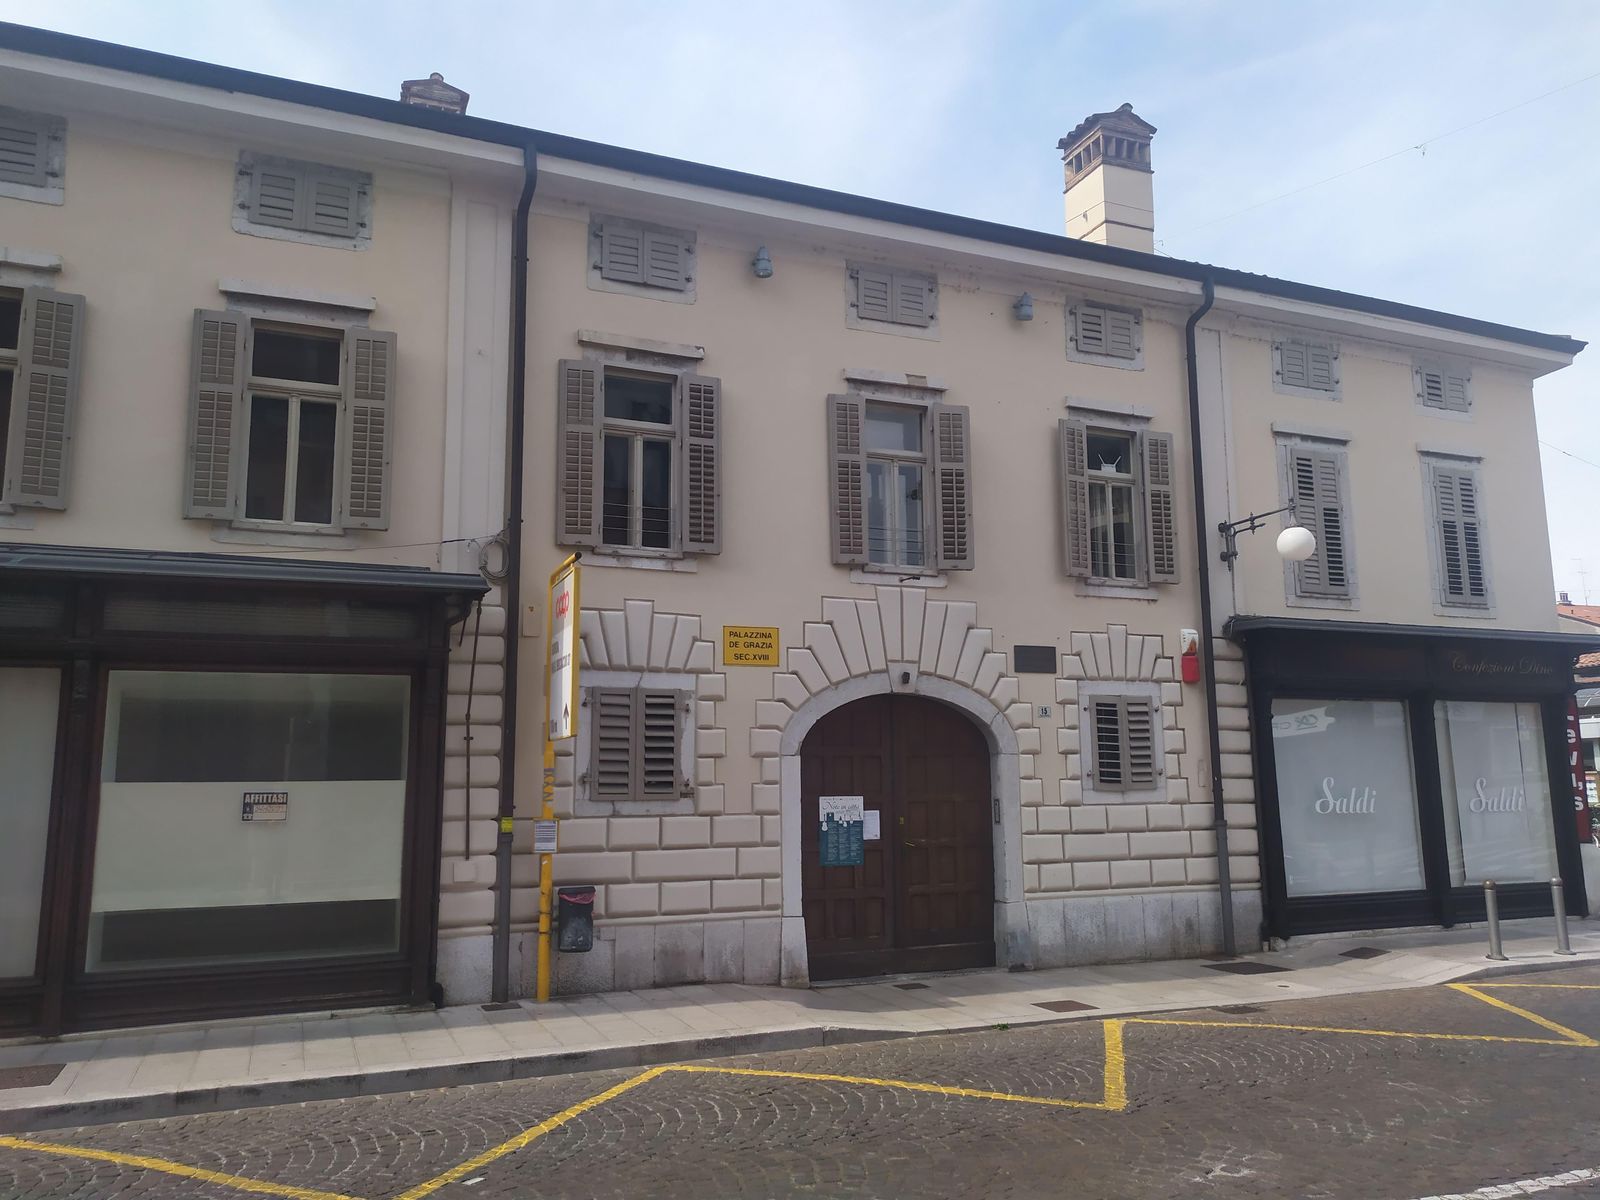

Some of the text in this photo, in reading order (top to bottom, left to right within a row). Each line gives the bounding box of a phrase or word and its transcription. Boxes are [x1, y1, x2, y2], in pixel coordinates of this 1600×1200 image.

[729, 631, 773, 639] PALAZZINA
[733, 653, 770, 661] SEC.XVIII
[1451, 654, 1515, 675] Confezioni
[1041, 707, 1048, 715] 15
[244, 793, 287, 803] AFFITTASI
[1315, 776, 1377, 814] Saldi
[1469, 777, 1524, 813] Saldi
